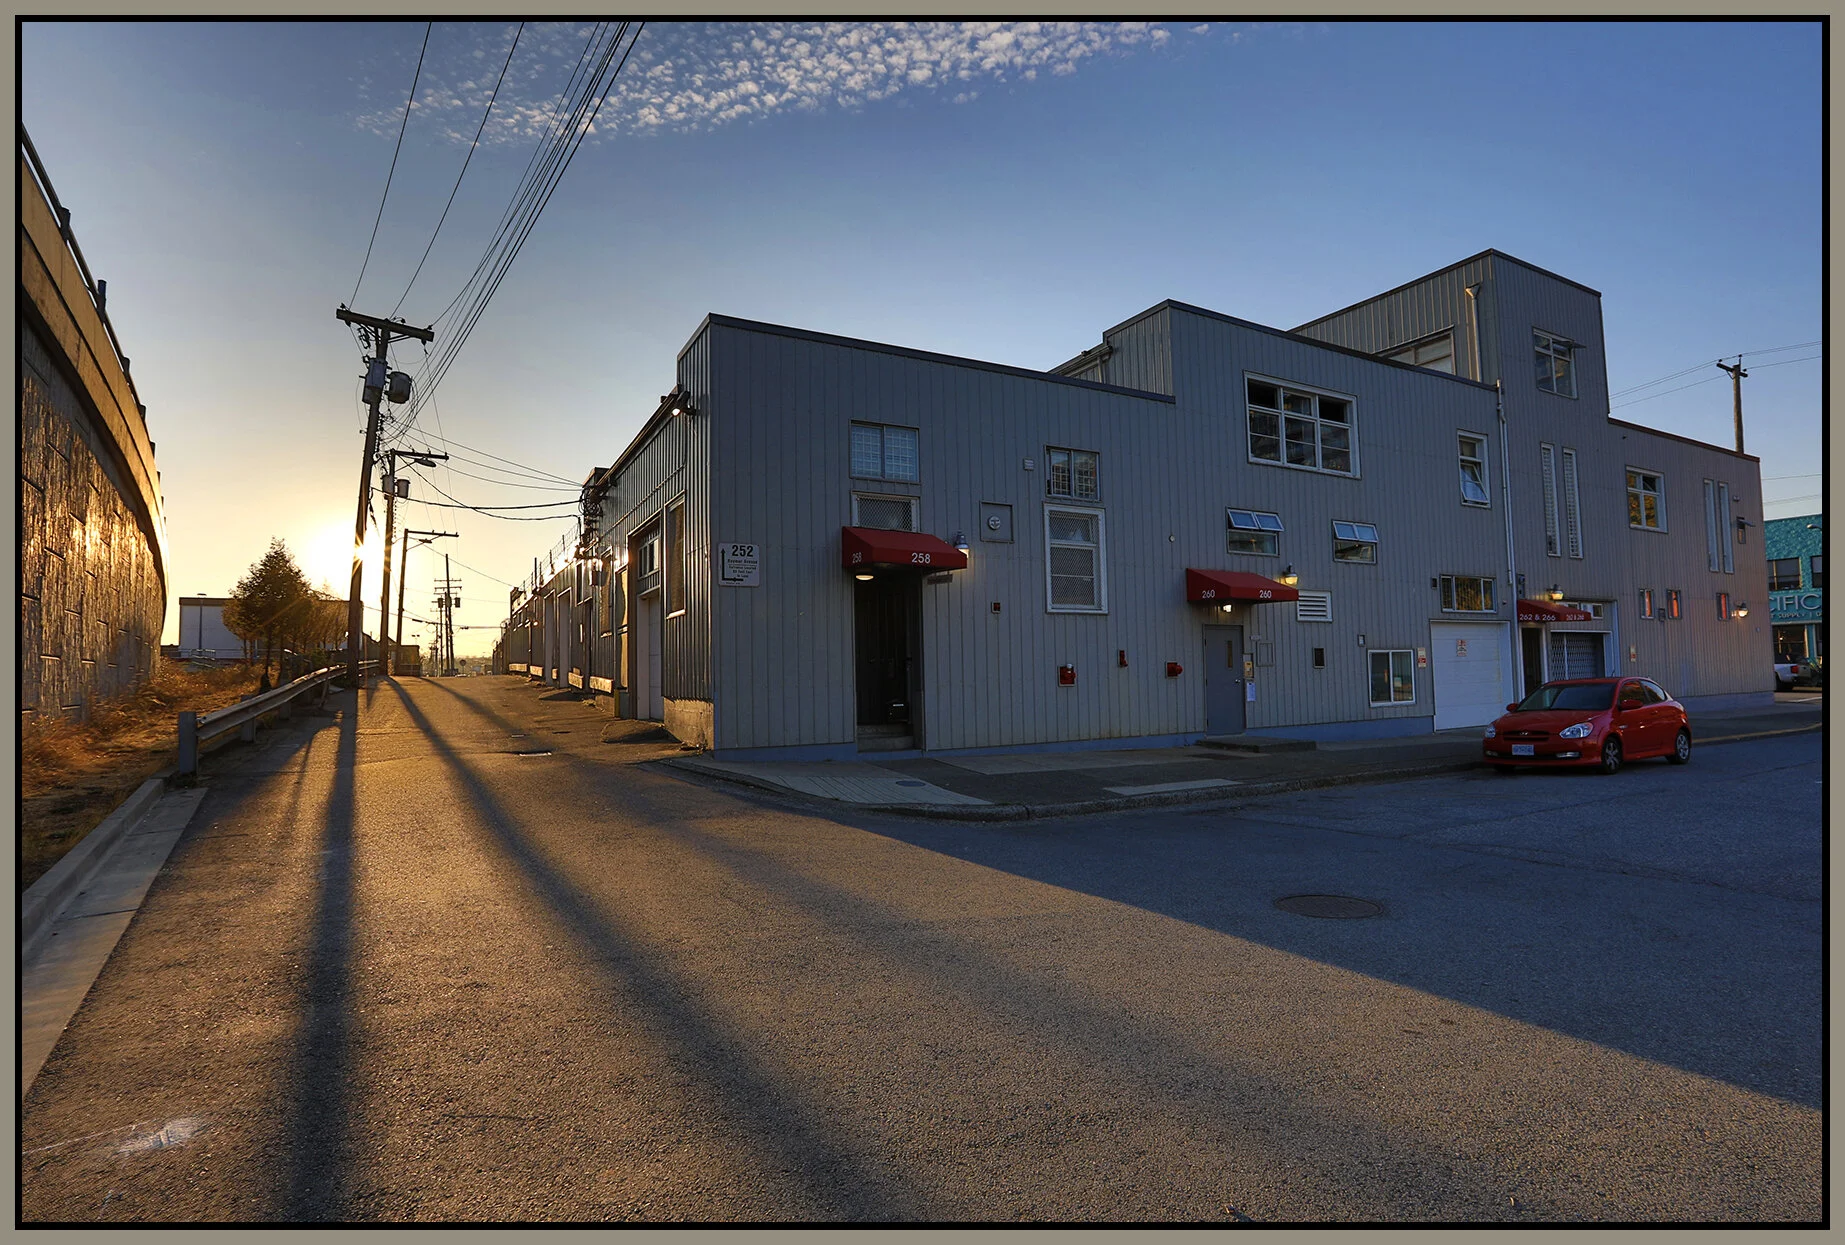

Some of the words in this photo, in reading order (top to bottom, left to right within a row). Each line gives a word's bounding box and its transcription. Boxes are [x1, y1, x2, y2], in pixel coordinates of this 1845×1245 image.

[732, 545, 753, 557] 252
[852, 552, 862, 563] 258
[911, 552, 931, 564] 258
[1202, 590, 1215, 598] 260
[1259, 590, 1272, 598] 260
